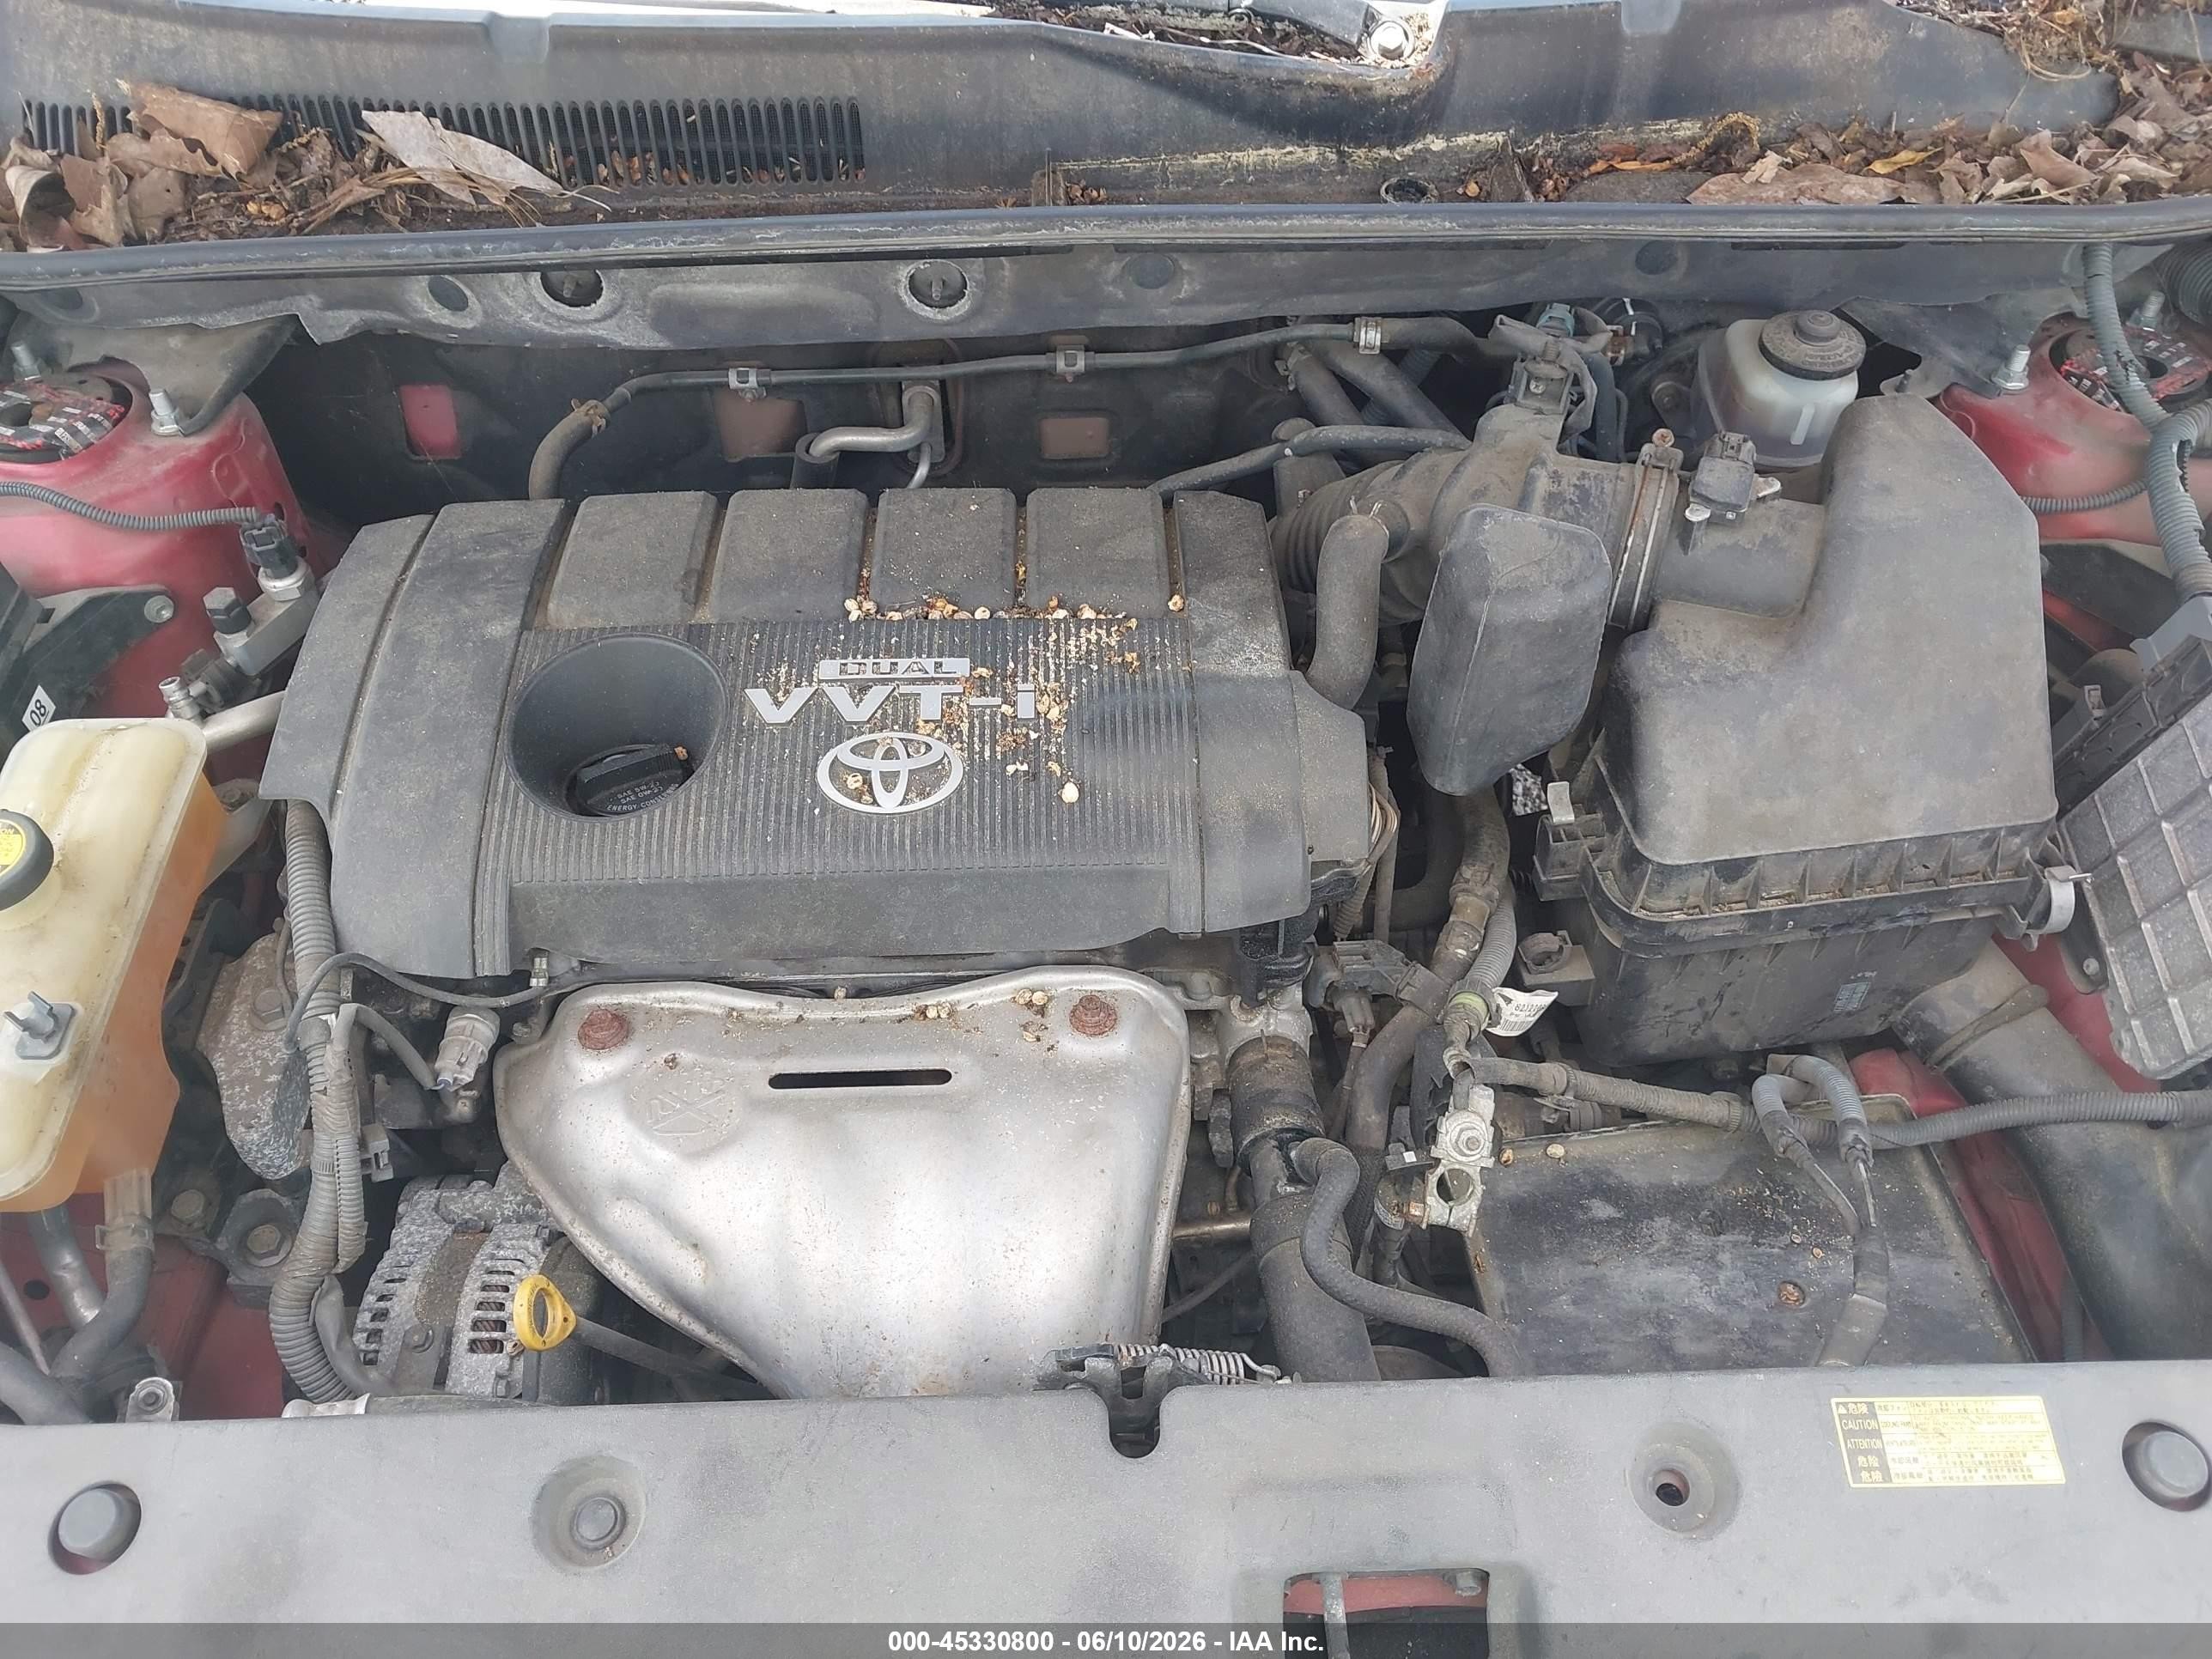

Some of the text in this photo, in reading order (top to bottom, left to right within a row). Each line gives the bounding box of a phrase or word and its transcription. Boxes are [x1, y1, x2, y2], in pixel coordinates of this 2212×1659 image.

[837, 660, 959, 676] DUAL
[744, 684, 1036, 724] VVT-i
[30, 699, 46, 726] 08
[620, 794, 636, 804] SAE
[1841, 1419, 1879, 1431] CAUTION
[1847, 1438, 1883, 1449] ATTENTION
